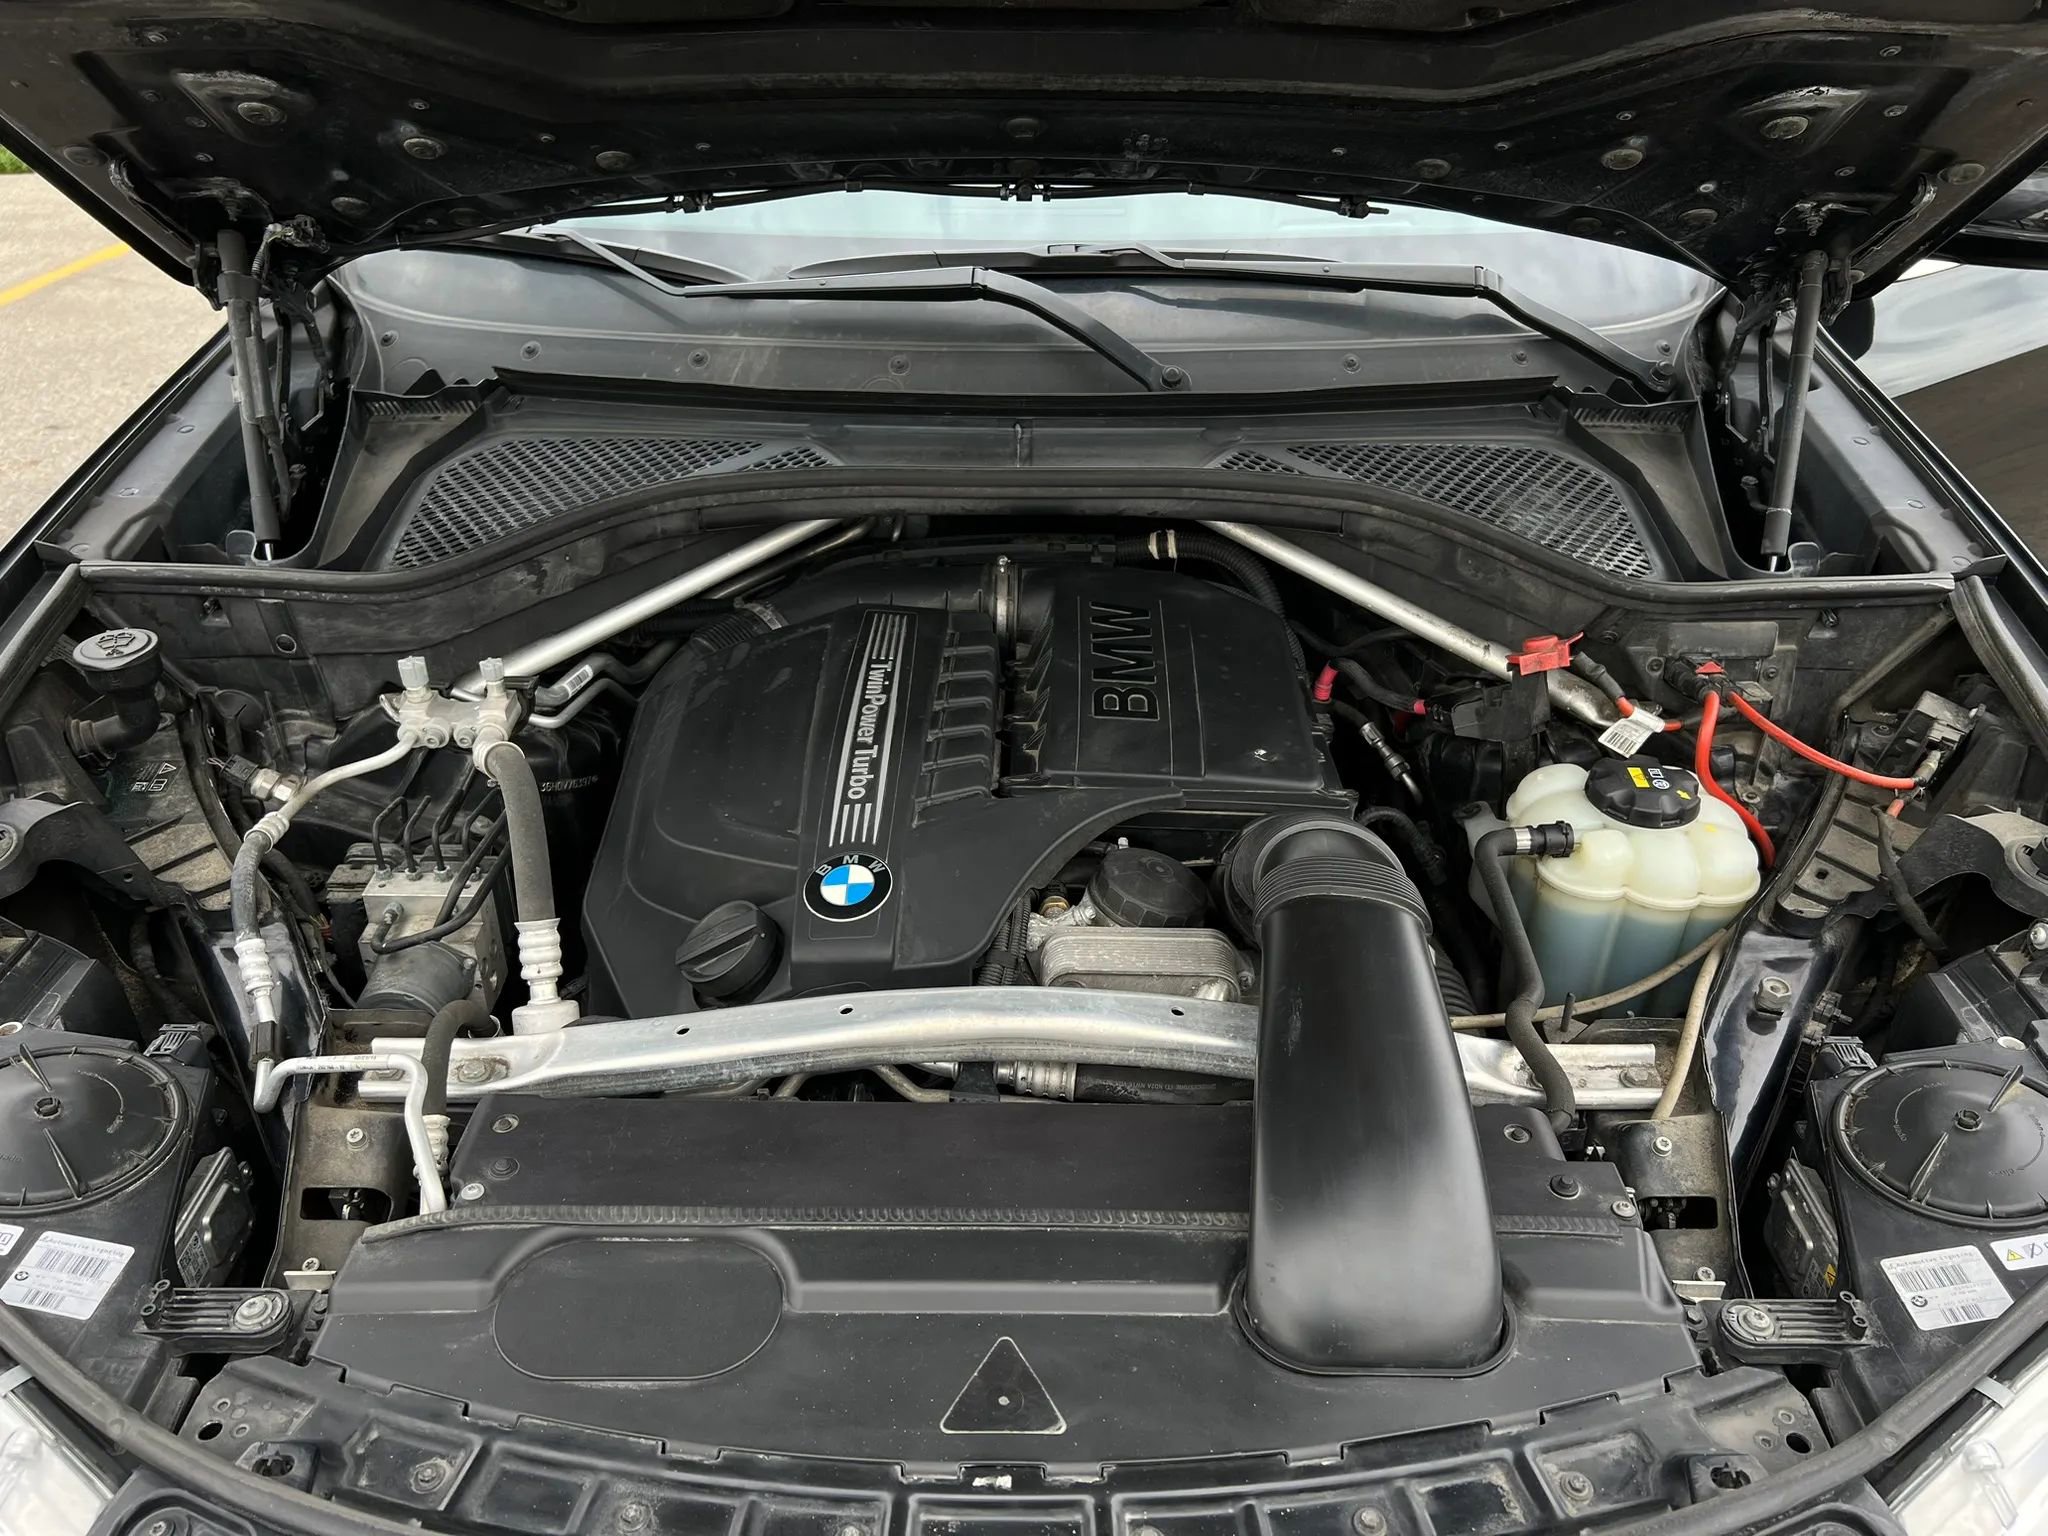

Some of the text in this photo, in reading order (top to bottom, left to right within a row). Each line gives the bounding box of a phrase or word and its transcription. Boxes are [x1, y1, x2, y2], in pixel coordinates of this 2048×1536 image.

[1089, 600, 1160, 721] BMW
[848, 661, 892, 800] TwinPower Turbo
[815, 854, 886, 877] BMW
